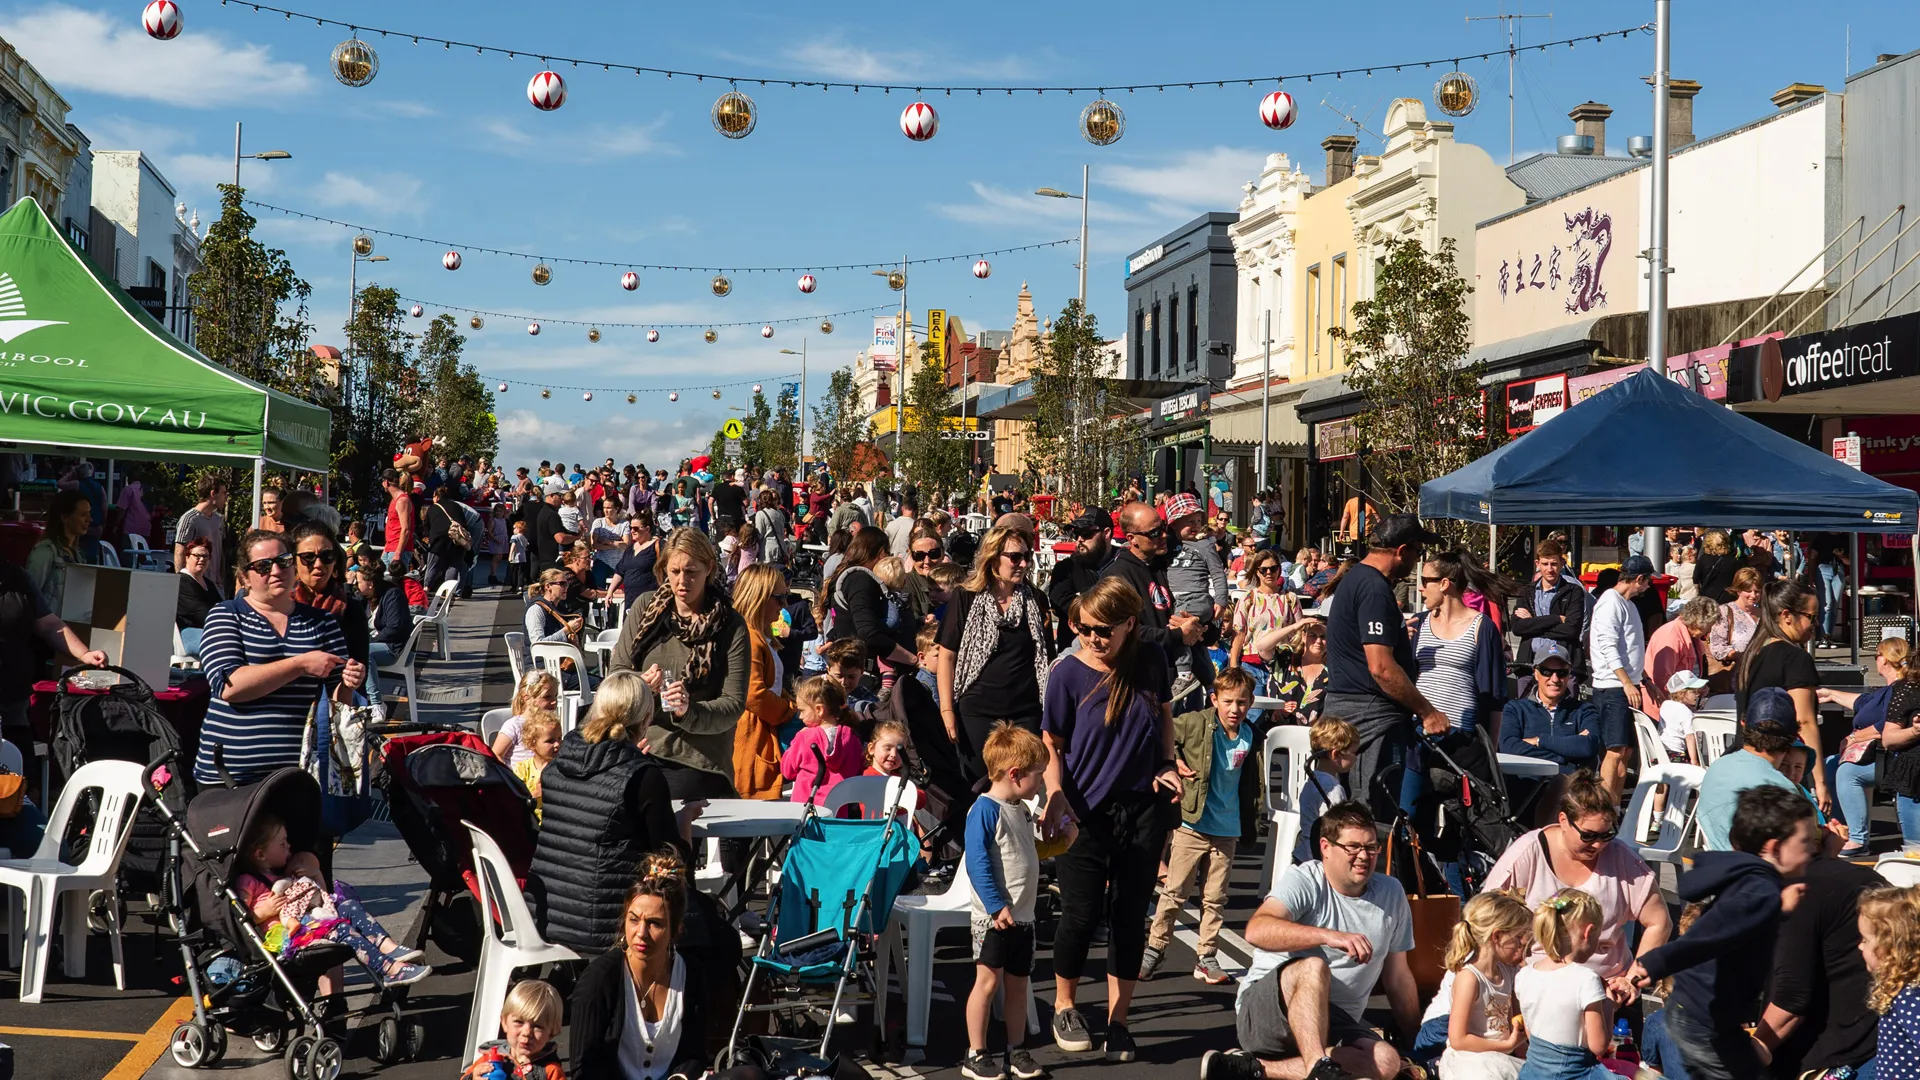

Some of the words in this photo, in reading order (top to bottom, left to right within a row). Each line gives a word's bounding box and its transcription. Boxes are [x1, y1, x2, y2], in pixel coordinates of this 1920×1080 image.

[875, 328, 895, 337] Find
[932, 312, 941, 338] REAL
[875, 337, 895, 346] Five
[1786, 334, 1893, 387] coffeetreat
[1534, 390, 1563, 411] EXPRESS
[1368, 621, 1384, 635] 19
